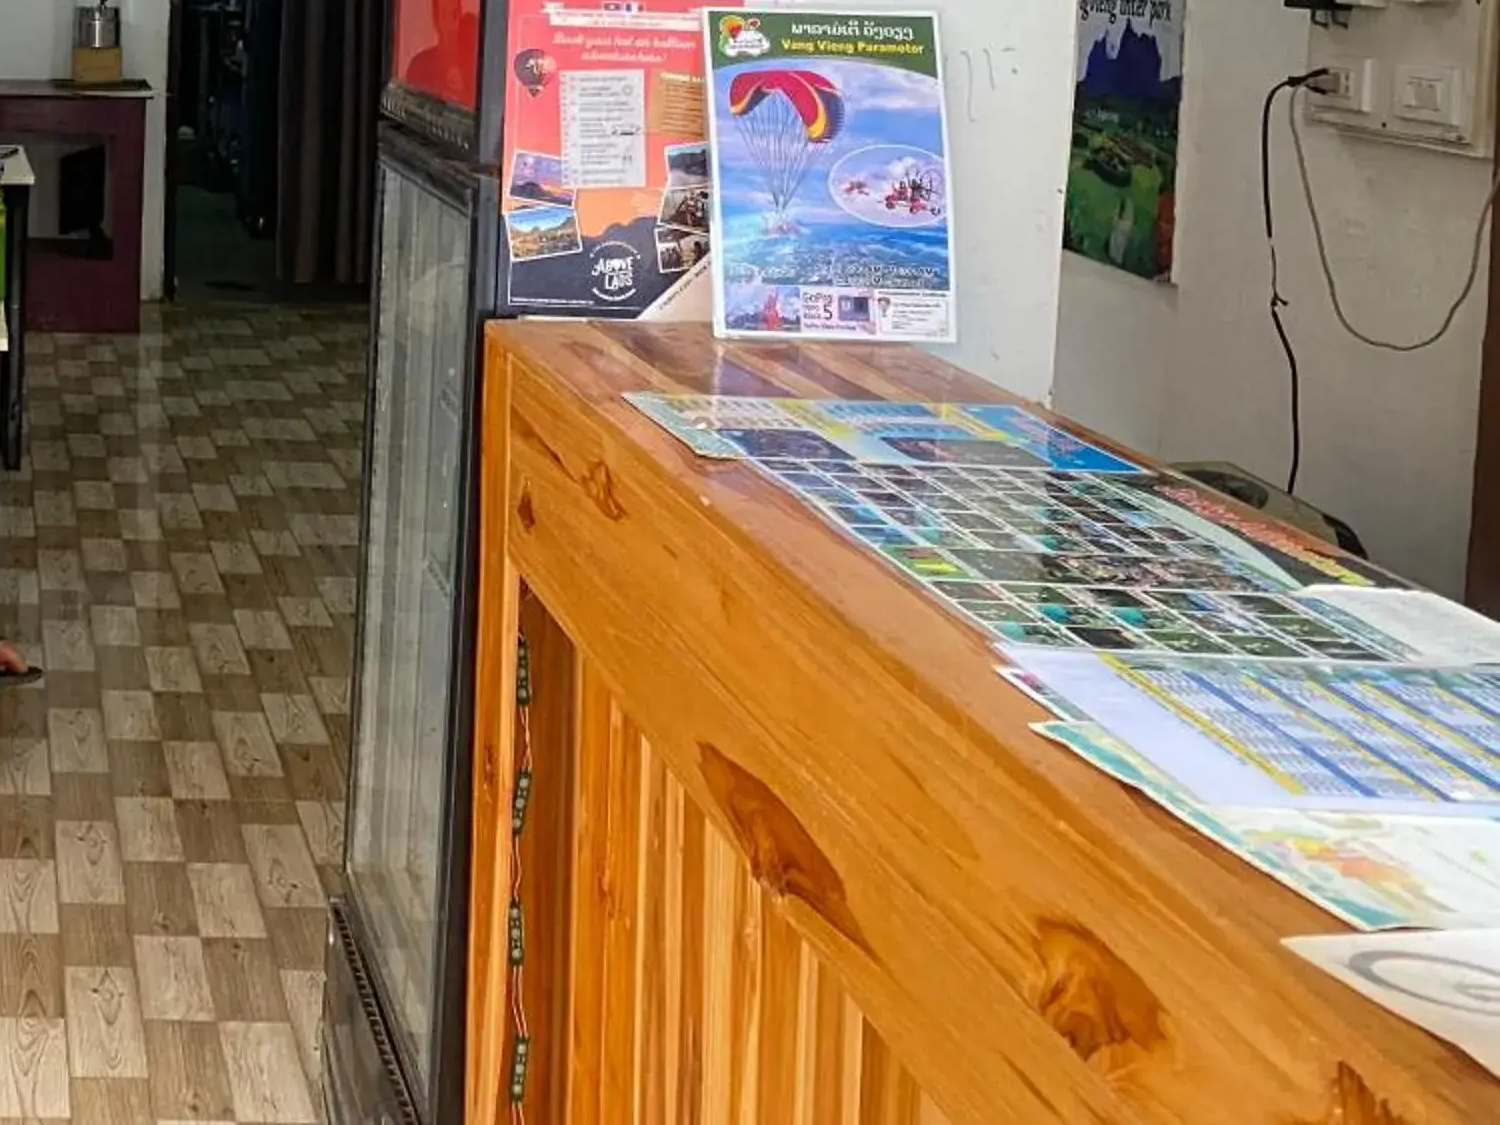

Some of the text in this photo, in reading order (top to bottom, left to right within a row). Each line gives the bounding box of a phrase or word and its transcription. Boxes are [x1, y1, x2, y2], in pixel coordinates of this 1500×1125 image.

[781, 38, 814, 53] Vang
[817, 39, 852, 55] Vieng
[856, 40, 925, 55] Paramotor
